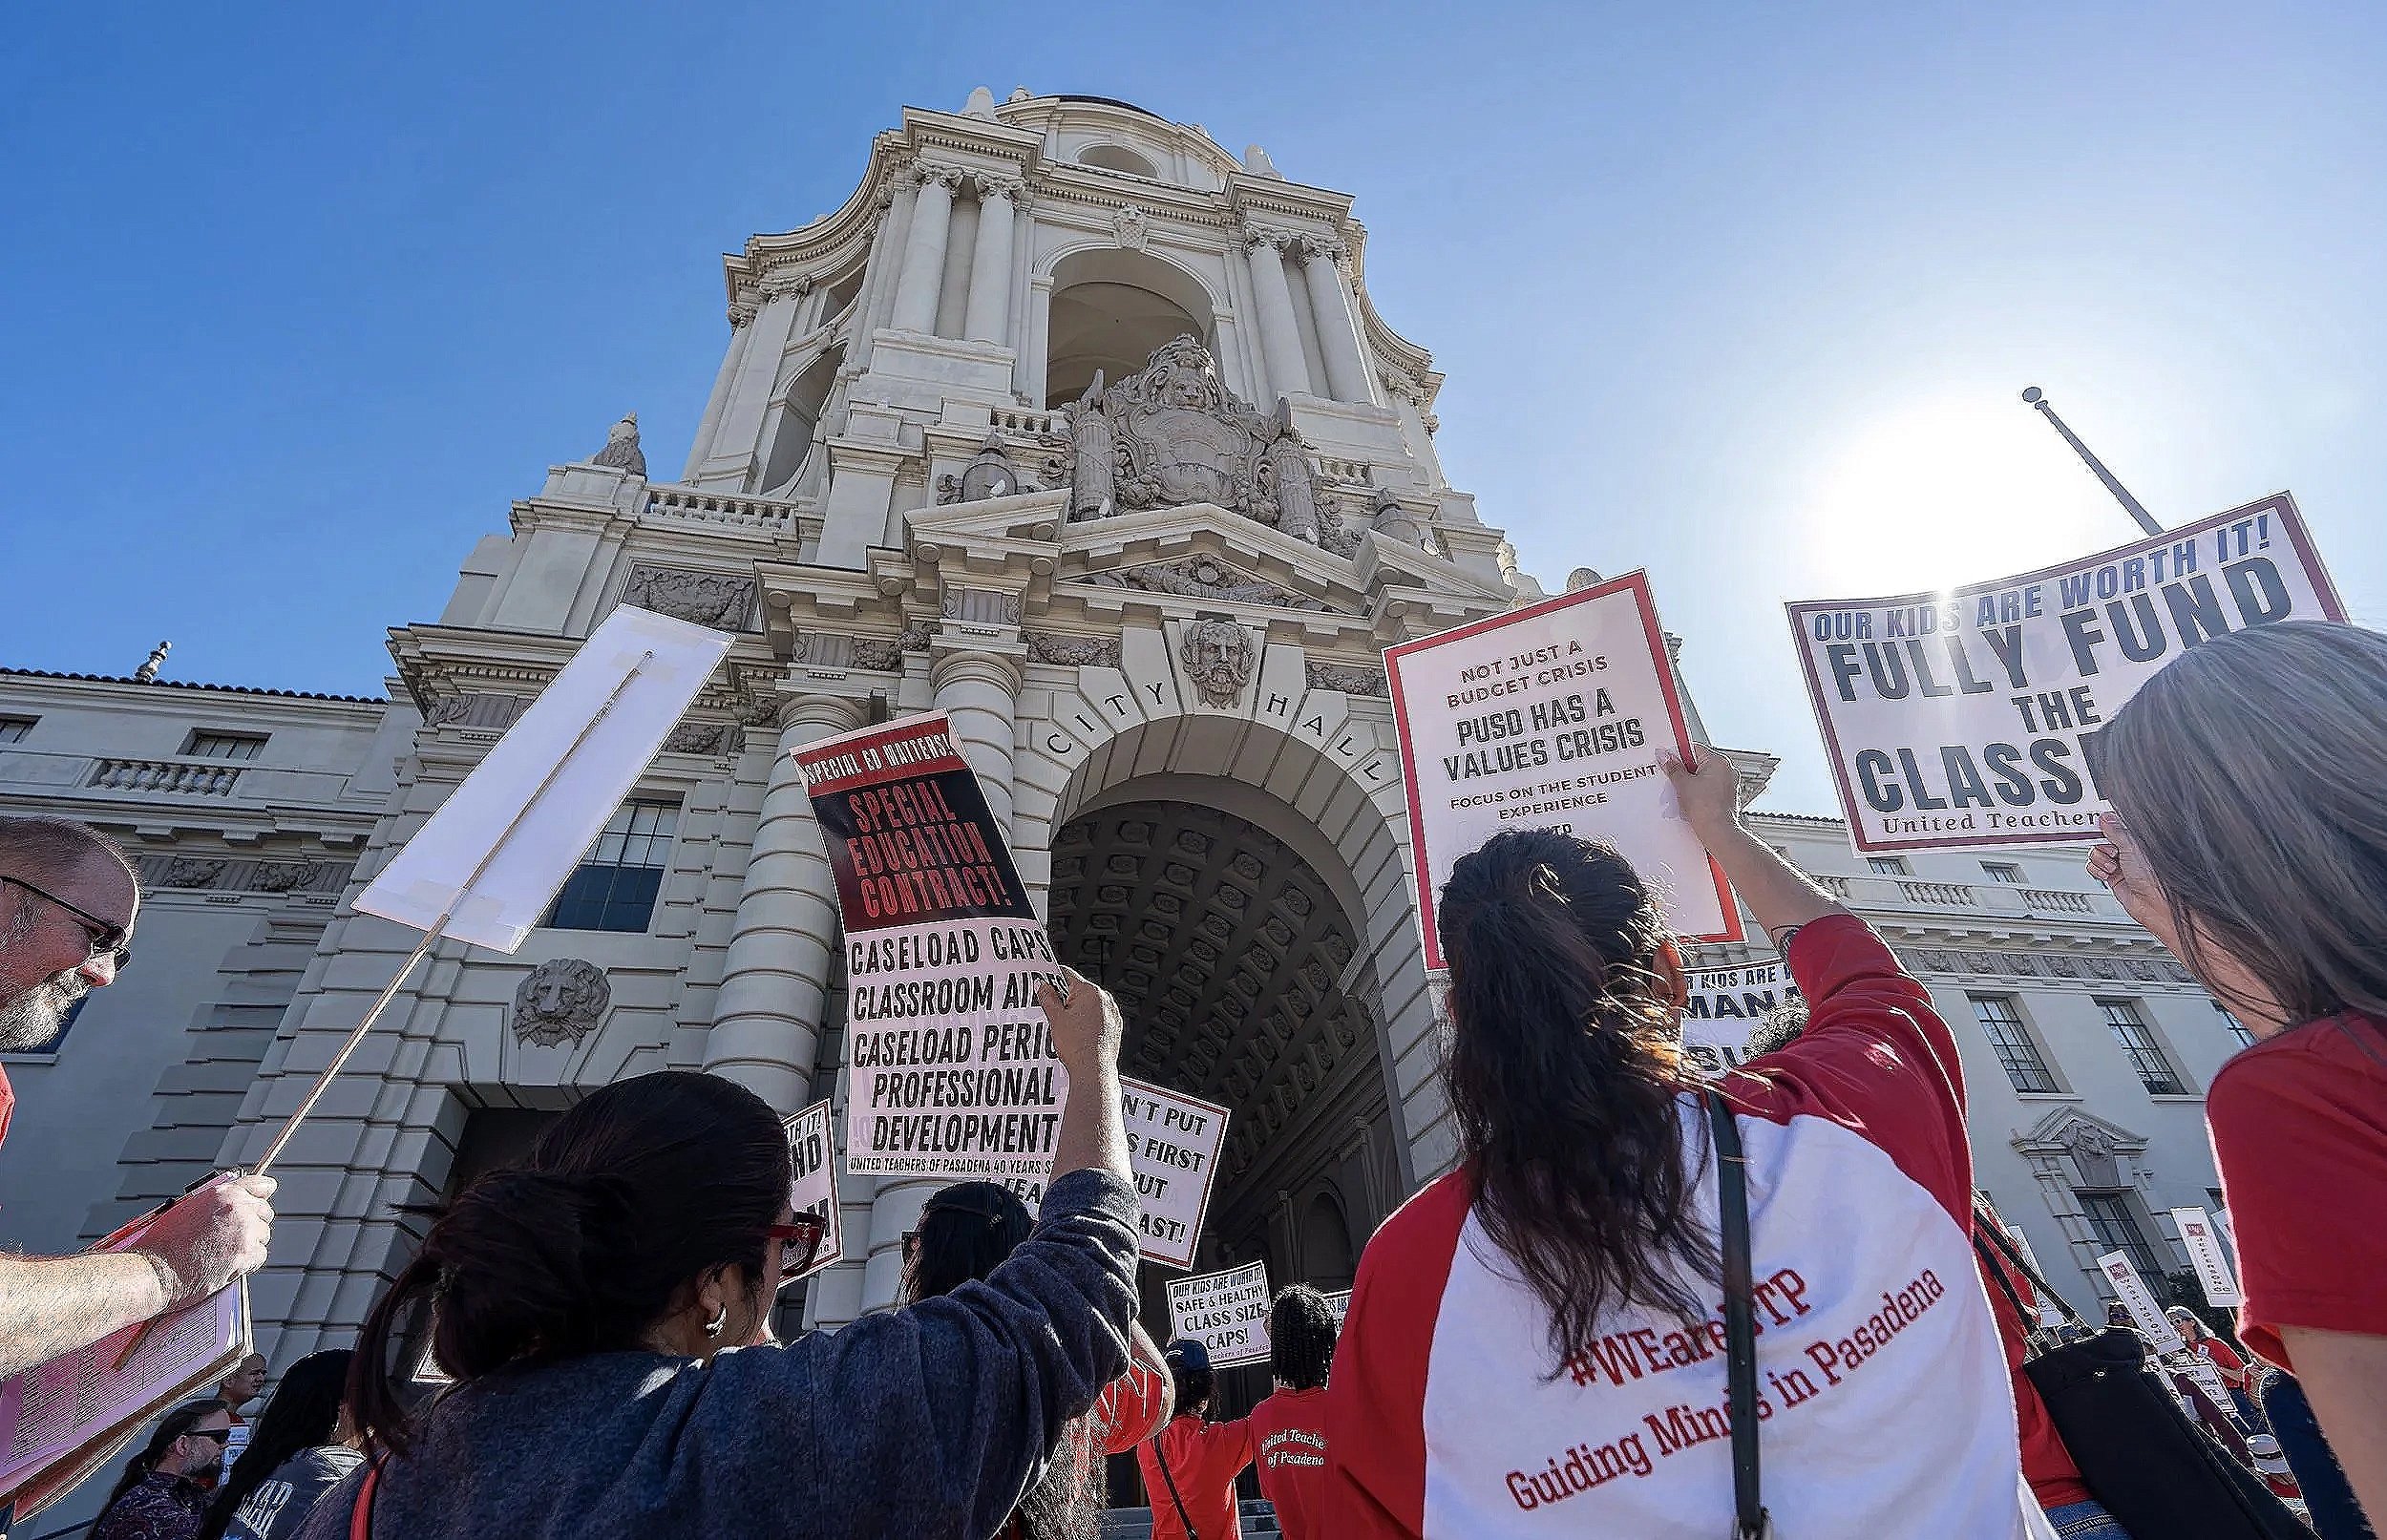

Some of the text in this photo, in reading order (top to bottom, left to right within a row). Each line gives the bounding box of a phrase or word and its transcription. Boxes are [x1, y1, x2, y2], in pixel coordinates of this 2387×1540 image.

[1814, 513, 2271, 642] OUR KIDS ARE WORTH IT!
[1826, 557, 2292, 703] FULLY FUND
[1447, 656, 1608, 709] BUDGET CRISIS
[1460, 639, 1583, 684] NOT JUST A
[1046, 682, 1383, 781] CITY HALL
[1457, 687, 1616, 748] PUSD HAS A
[2011, 686, 2101, 734] THE
[805, 732, 955, 785] SPECIAL ED MATTERS!
[1444, 717, 1646, 782] VALUES CRISIS
[848, 779, 957, 833] SPECIAL
[1450, 764, 1658, 811] FOCUS ON THE STUDENT
[1498, 791, 1608, 821] EXPERIENCE
[1883, 811, 2100, 835] United Teacher
[846, 821, 994, 876] EDUCATION
[860, 865, 1013, 919] CONTRACT!
[851, 926, 1053, 976] CASELOAD CAPS
[854, 974, 994, 1022] CLASSROOM
[1701, 972, 1739, 990] KIDS
[1744, 965, 1777, 986] ARE
[854, 1026, 972, 1068] CASELOAD
[872, 1066, 1056, 1108] PROFESSIONAL
[873, 1113, 1059, 1153] DEVELOPMENT
[1122, 1093, 1208, 1137] N'T PUT
[850, 1157, 882, 1171] UNITED
[884, 1157, 926, 1172] TEACHERS
[929, 1158, 940, 1172] OF
[943, 1158, 990, 1174] PASADENA
[994, 1159, 1006, 1174] 40
[1010, 1159, 1042, 1174] YEARS
[1145, 1137, 1206, 1174] FIRST
[1139, 1213, 1187, 1244] AST!
[1173, 1283, 1191, 1298] OUR
[1193, 1279, 1212, 1295] KIDS
[1213, 1276, 1229, 1291] ARE
[1230, 1269, 1254, 1287] WORTH
[1175, 1284, 1264, 1314] SAFE & HEALTHY
[1184, 1302, 1265, 1332] CLASS SIZE
[1206, 1327, 1250, 1350] CAPS!
[1506, 1268, 1946, 1512] Guiding Mins in Pasadena
[1267, 1451, 1279, 1468] of
